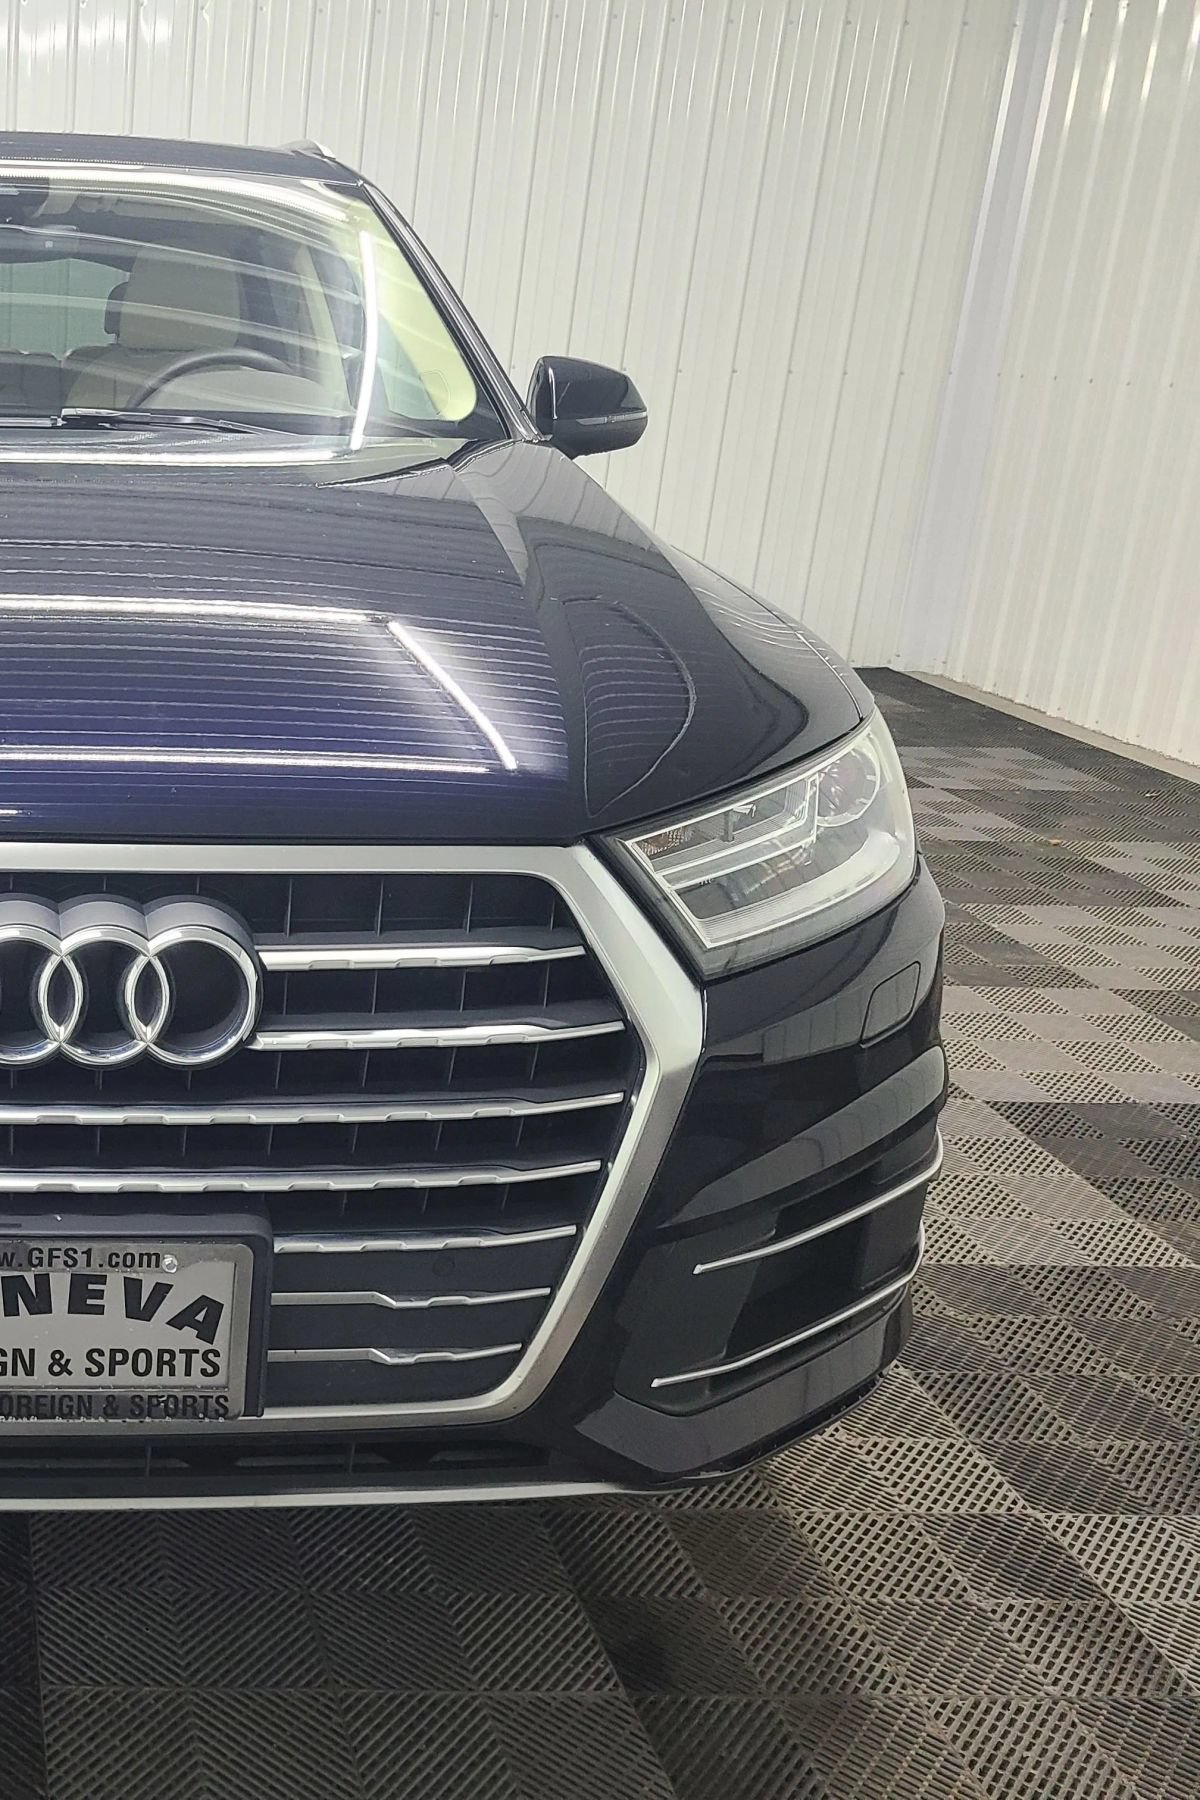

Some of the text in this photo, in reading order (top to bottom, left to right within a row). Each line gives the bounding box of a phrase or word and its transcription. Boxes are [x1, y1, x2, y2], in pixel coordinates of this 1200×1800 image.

[48, 1348, 73, 1377] &
[85, 1348, 221, 1379] SPORTS
[103, 1395, 119, 1416] &
[131, 1394, 230, 1418] SPORTS
